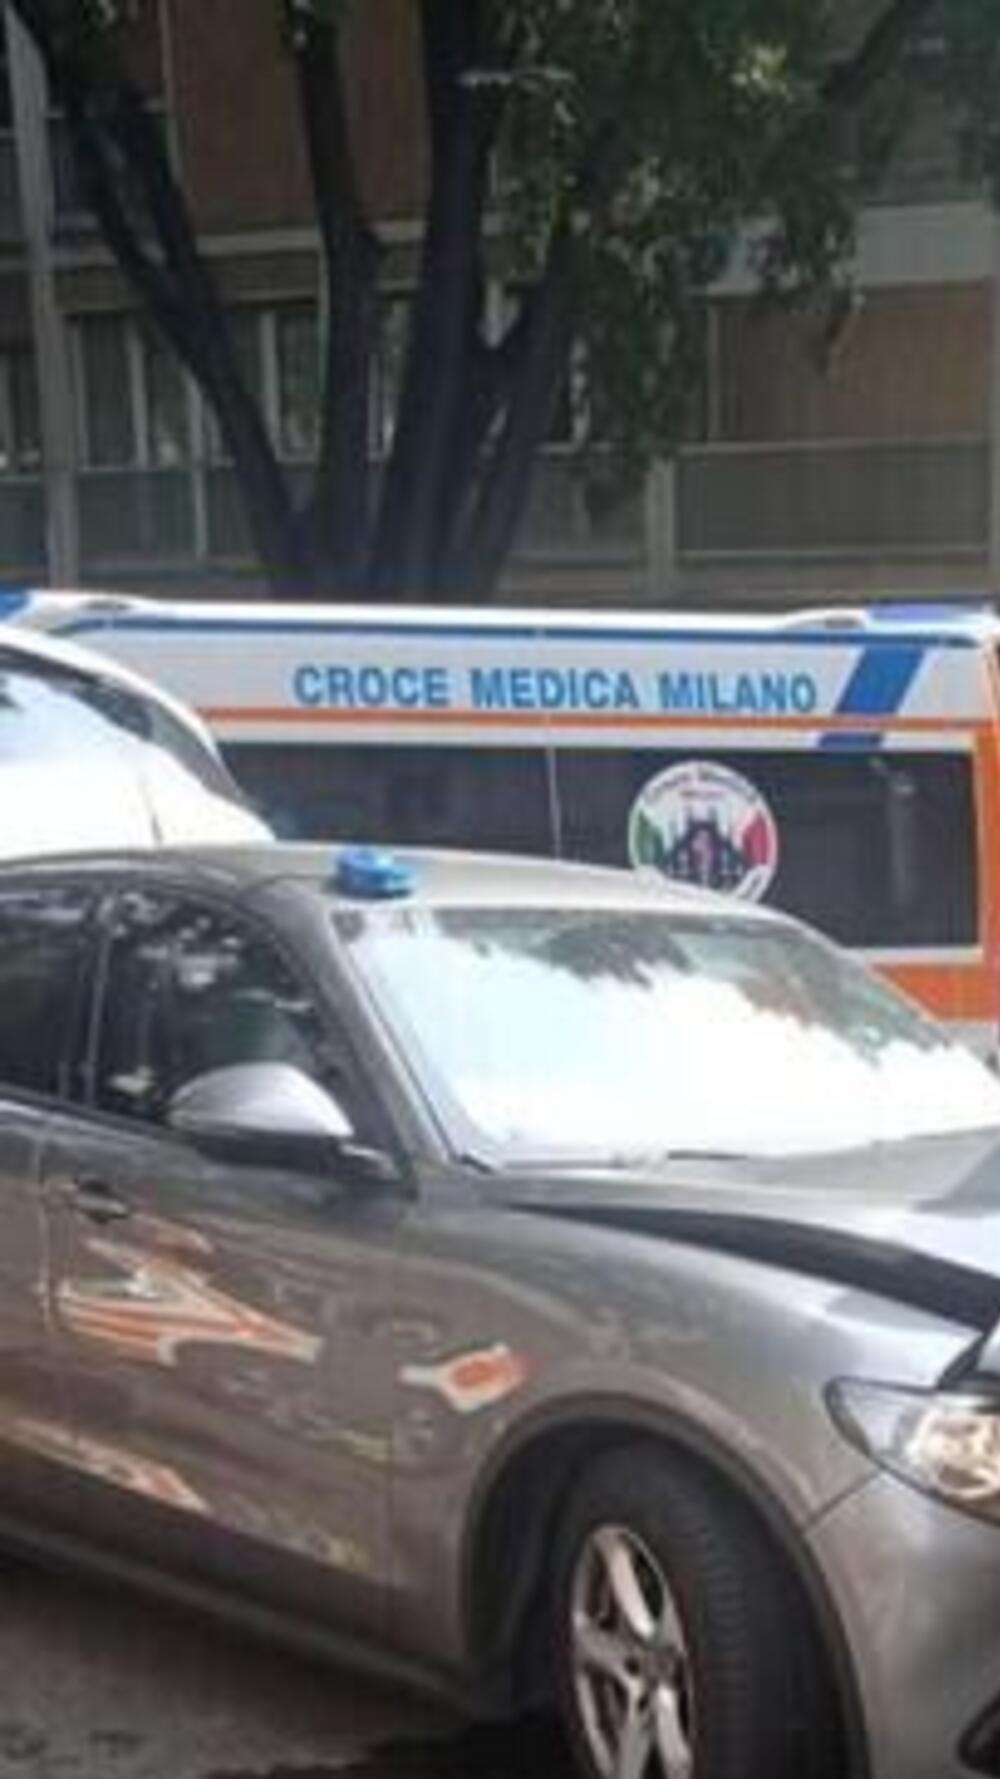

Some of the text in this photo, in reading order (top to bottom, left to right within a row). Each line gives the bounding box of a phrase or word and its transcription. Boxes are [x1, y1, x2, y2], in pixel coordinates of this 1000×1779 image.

[293, 666, 818, 713] CROCE MEDICA MILANO
